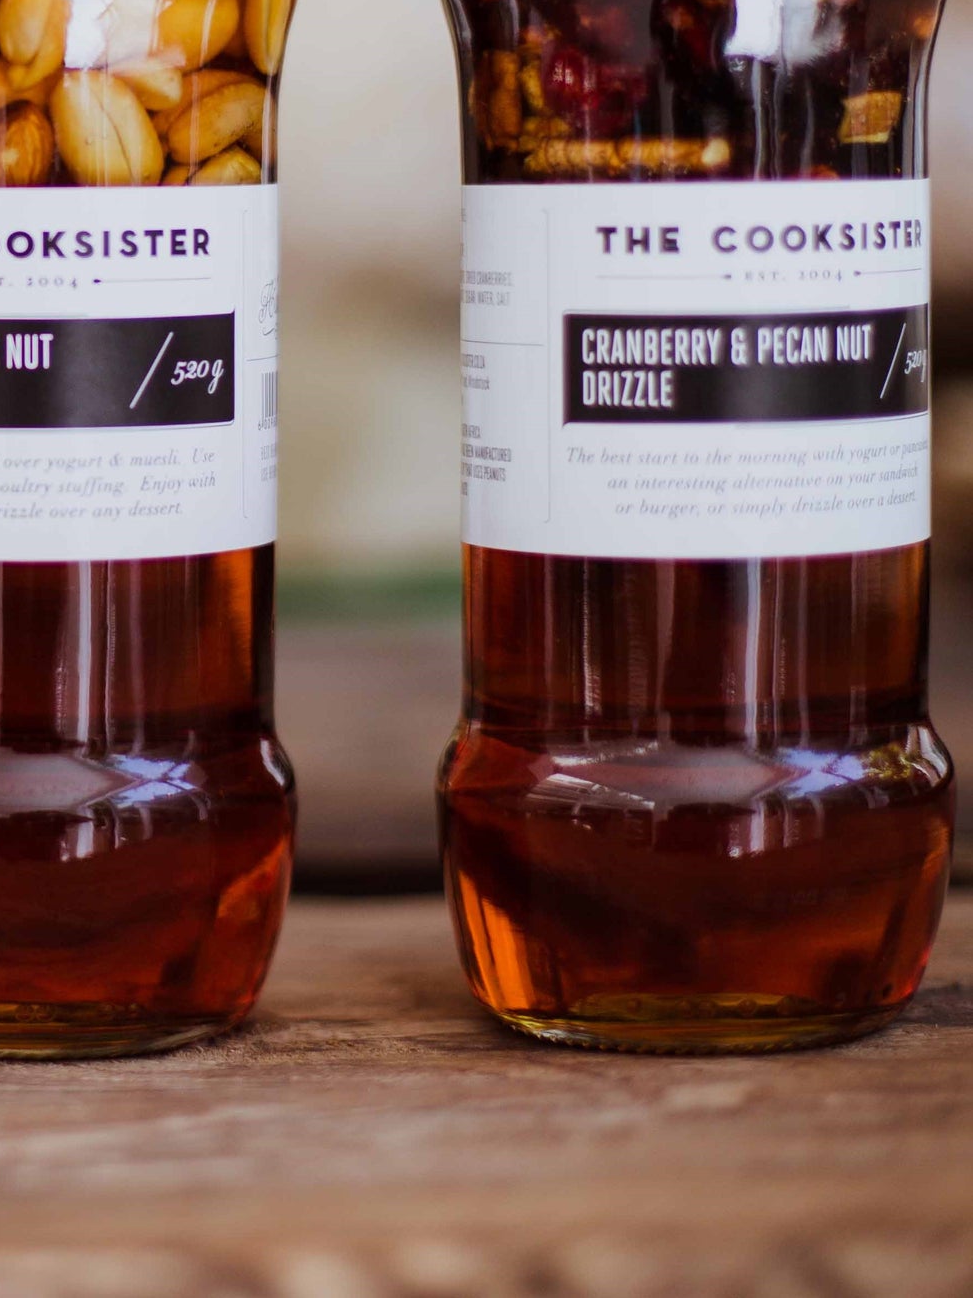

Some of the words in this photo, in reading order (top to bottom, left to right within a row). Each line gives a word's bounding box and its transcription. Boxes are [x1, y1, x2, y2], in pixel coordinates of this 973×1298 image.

[595, 226, 680, 254] THE
[712, 219, 922, 254] COOKSISTER
[26, 276, 78, 289] 2004
[5, 333, 54, 370] NUT
[582, 327, 723, 366] CRANBERRY
[730, 326, 749, 366] &
[757, 325, 828, 365] PECAN
[836, 323, 871, 362] NUT
[170, 359, 224, 395] 520g
[582, 370, 673, 408] DRIZZLE
[2, 459, 40, 469] over
[46, 455, 103, 473] yogurt
[109, 453, 123, 468] &
[192, 447, 216, 464] Use
[566, 446, 595, 464] The
[600, 449, 633, 464] best
[638, 450, 678, 465] start
[683, 451, 699, 465] to
[705, 448, 732, 465] the
[737, 452, 807, 467] morning
[812, 444, 845, 462] with
[847, 445, 887, 464] yogurt
[889, 445, 901, 456] or
[140, 474, 185, 495] Enjoy
[188, 471, 217, 488] with
[606, 477, 628, 490] an
[633, 474, 728, 496] interesting
[732, 473, 823, 490] alternative
[827, 475, 843, 487] on
[847, 471, 877, 489] your
[49, 506, 87, 519] over
[92, 506, 124, 522] any
[614, 504, 635, 515] or
[706, 504, 726, 515] or
[732, 497, 786, 519] simply
[791, 494, 843, 513] drizzle
[846, 497, 875, 510] over
[877, 496, 884, 507] a
